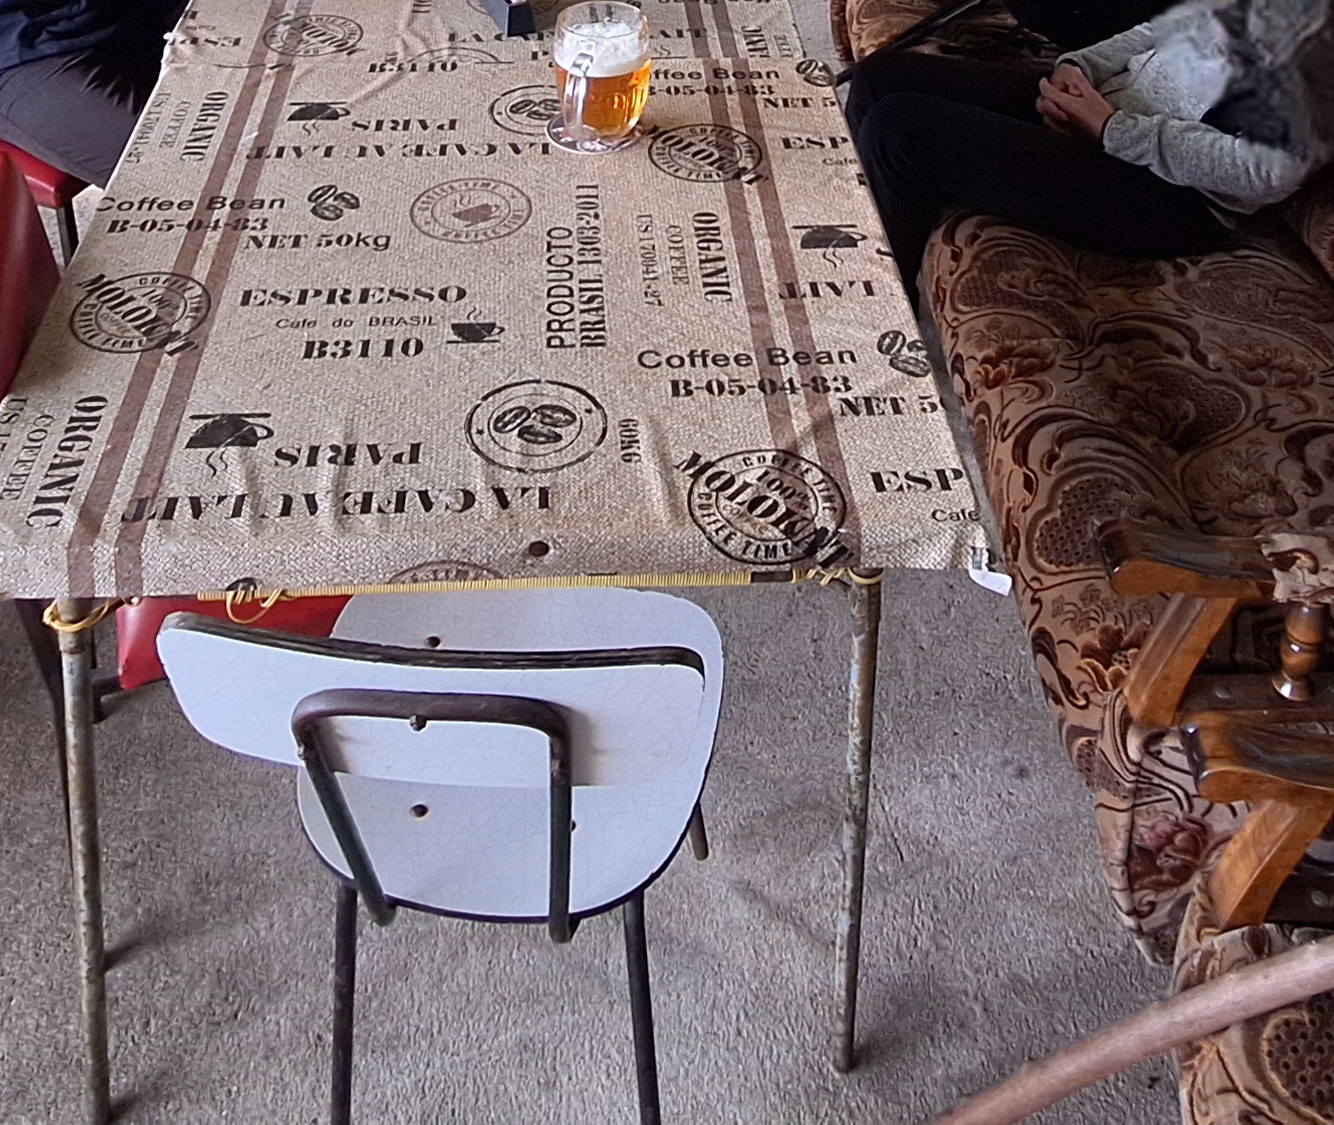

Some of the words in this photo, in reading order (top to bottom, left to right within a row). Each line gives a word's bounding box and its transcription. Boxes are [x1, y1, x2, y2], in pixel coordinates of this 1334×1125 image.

[649, 67, 704, 81] ffee
[712, 67, 781, 81] Bean
[762, 96, 815, 110] NET
[822, 96, 838, 108] 5
[179, 91, 230, 163] ORGANIC
[351, 118, 459, 132] PARIS
[780, 135, 851, 151] ESP
[96, 195, 195, 213] Coffee
[205, 195, 287, 211] Bean
[105, 216, 270, 234] B-05-04-83
[244, 232, 309, 251] NET
[316, 232, 393, 253] 50kg
[666, 224, 691, 286] COFFEE
[692, 211, 734, 304] ORGANIC
[239, 285, 468, 307] ESPRESSO
[545, 225, 577, 350] PRODUCTO
[368, 315, 438, 327] BRASIL
[578, 274, 608, 350] BRASIL
[301, 336, 425, 360] B3110
[636, 348, 754, 370] Coffee
[767, 347, 858, 367] Bean
[669, 374, 854, 398] B-05-04-83
[0, 397, 29, 425] US
[836, 395, 907, 417] NET
[917, 394, 940, 414] 5
[24, 394, 109, 528] ORGANIC
[272, 442, 424, 469] PARIS
[868, 466, 967, 493] ESP
[121, 492, 251, 523] LAIT
[341, 488, 478, 516] CAFE
[490, 486, 553, 511] LA
[931, 507, 982, 523] Cafe
